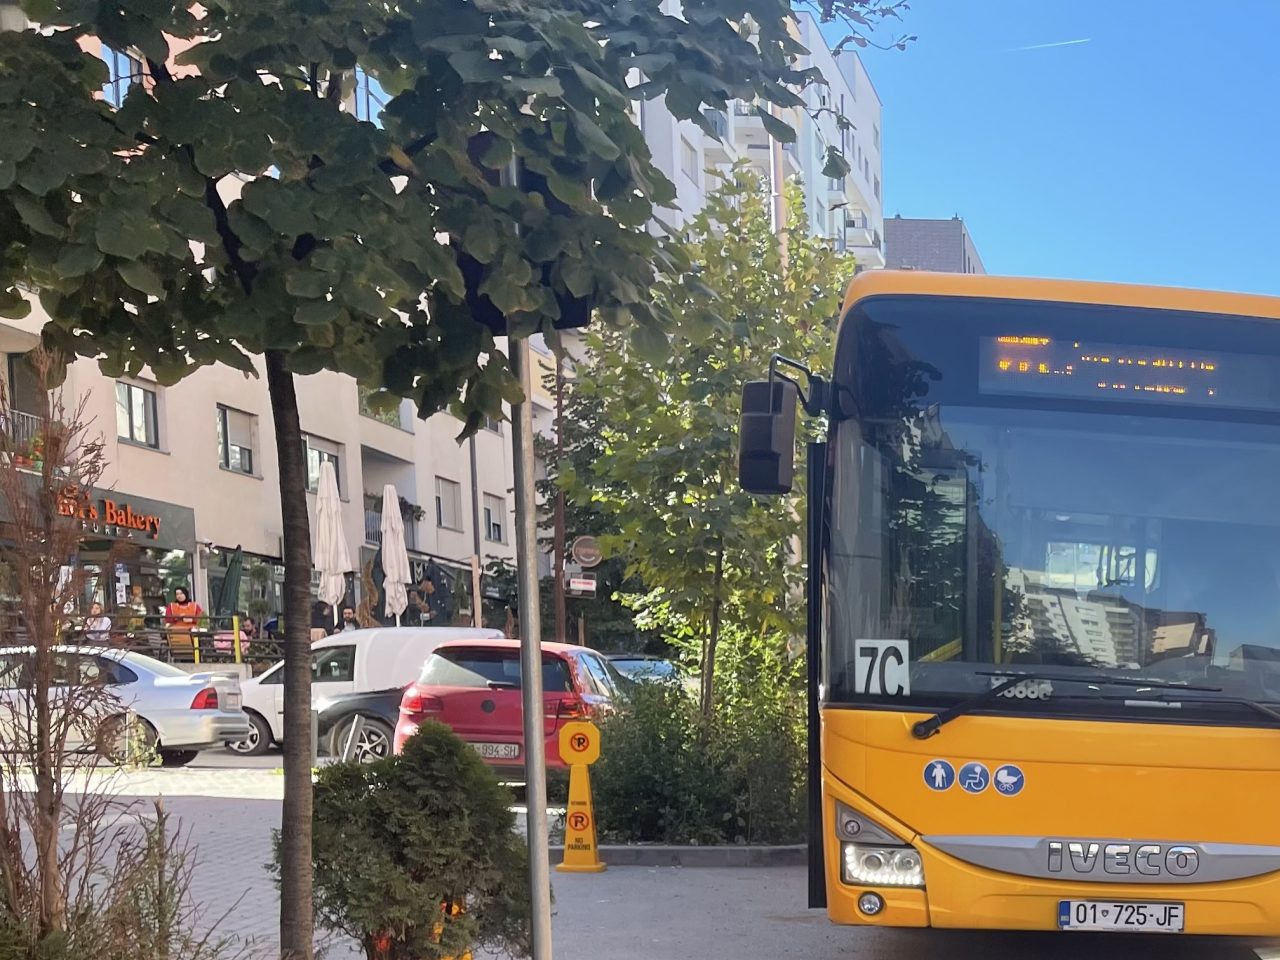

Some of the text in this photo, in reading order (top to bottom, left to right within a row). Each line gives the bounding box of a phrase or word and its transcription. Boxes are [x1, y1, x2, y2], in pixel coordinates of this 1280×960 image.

[105, 499, 161, 540] Bakery
[859, 645, 904, 696] 7C
[1048, 841, 1199, 876] IVECO
